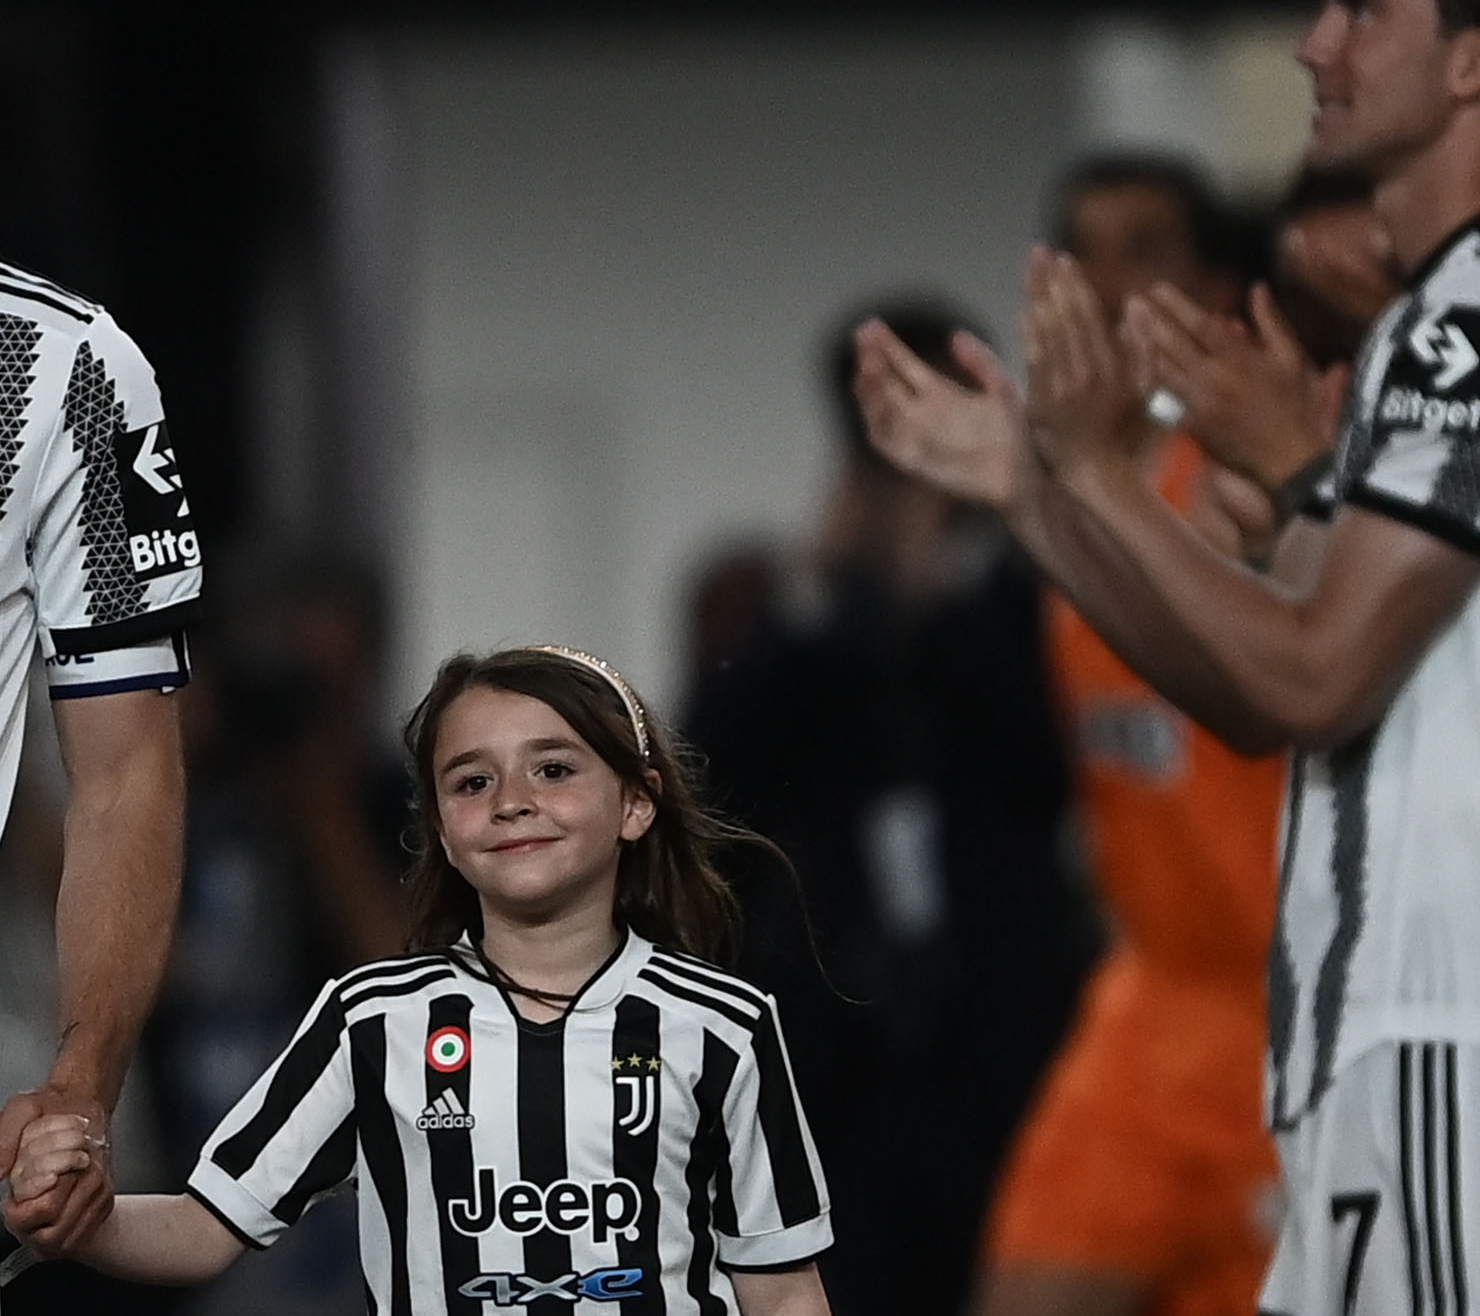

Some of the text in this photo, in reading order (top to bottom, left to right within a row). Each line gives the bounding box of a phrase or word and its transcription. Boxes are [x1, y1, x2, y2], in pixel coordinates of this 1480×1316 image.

[129, 529, 202, 573] Bitg
[417, 1112, 475, 1131] adidas
[448, 1168, 641, 1243] Jeep
